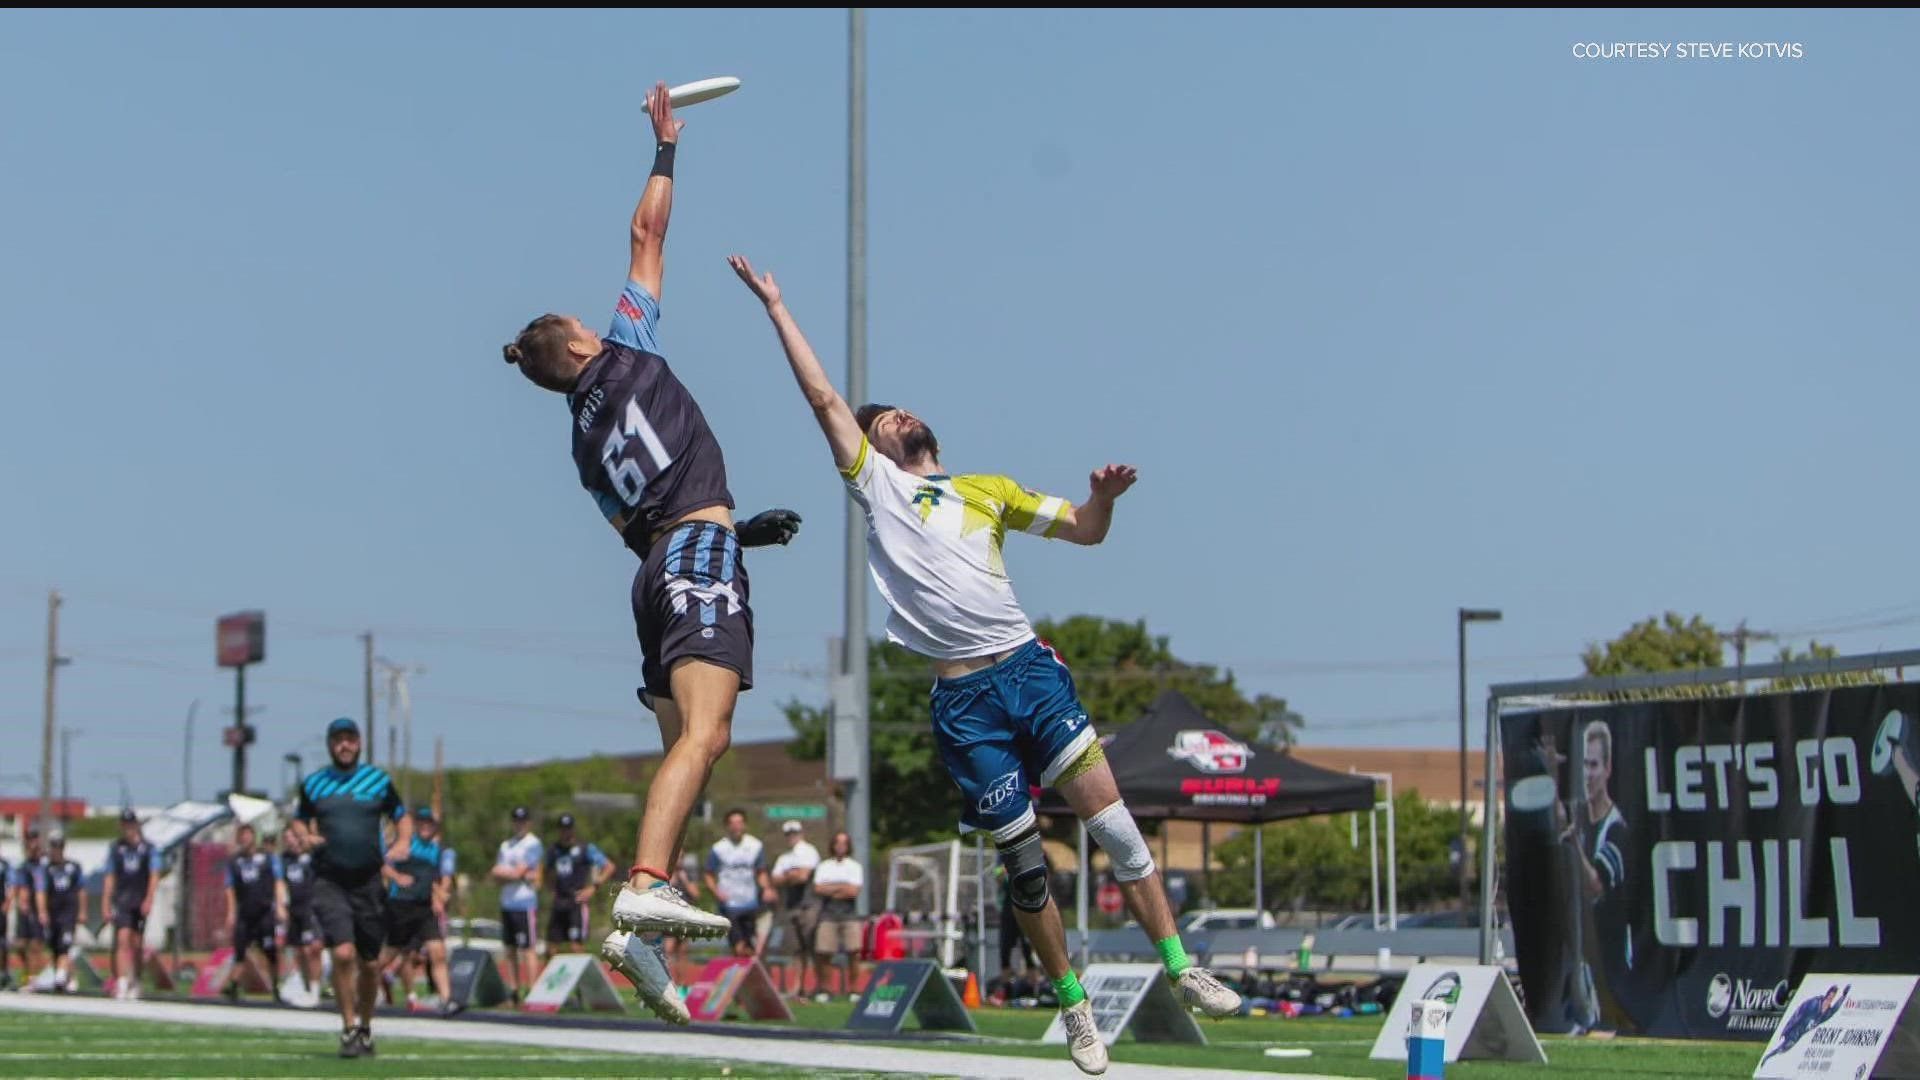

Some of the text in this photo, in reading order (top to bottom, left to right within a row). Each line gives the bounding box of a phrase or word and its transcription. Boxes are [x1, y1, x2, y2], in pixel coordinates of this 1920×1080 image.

[601, 393, 673, 507] 61
[984, 780, 1015, 806] TDS
[1645, 737, 1861, 812] LET'S GO
[1651, 836, 1880, 948] CHILL
[1810, 1027, 1883, 1047] BRENT JOHNSON
